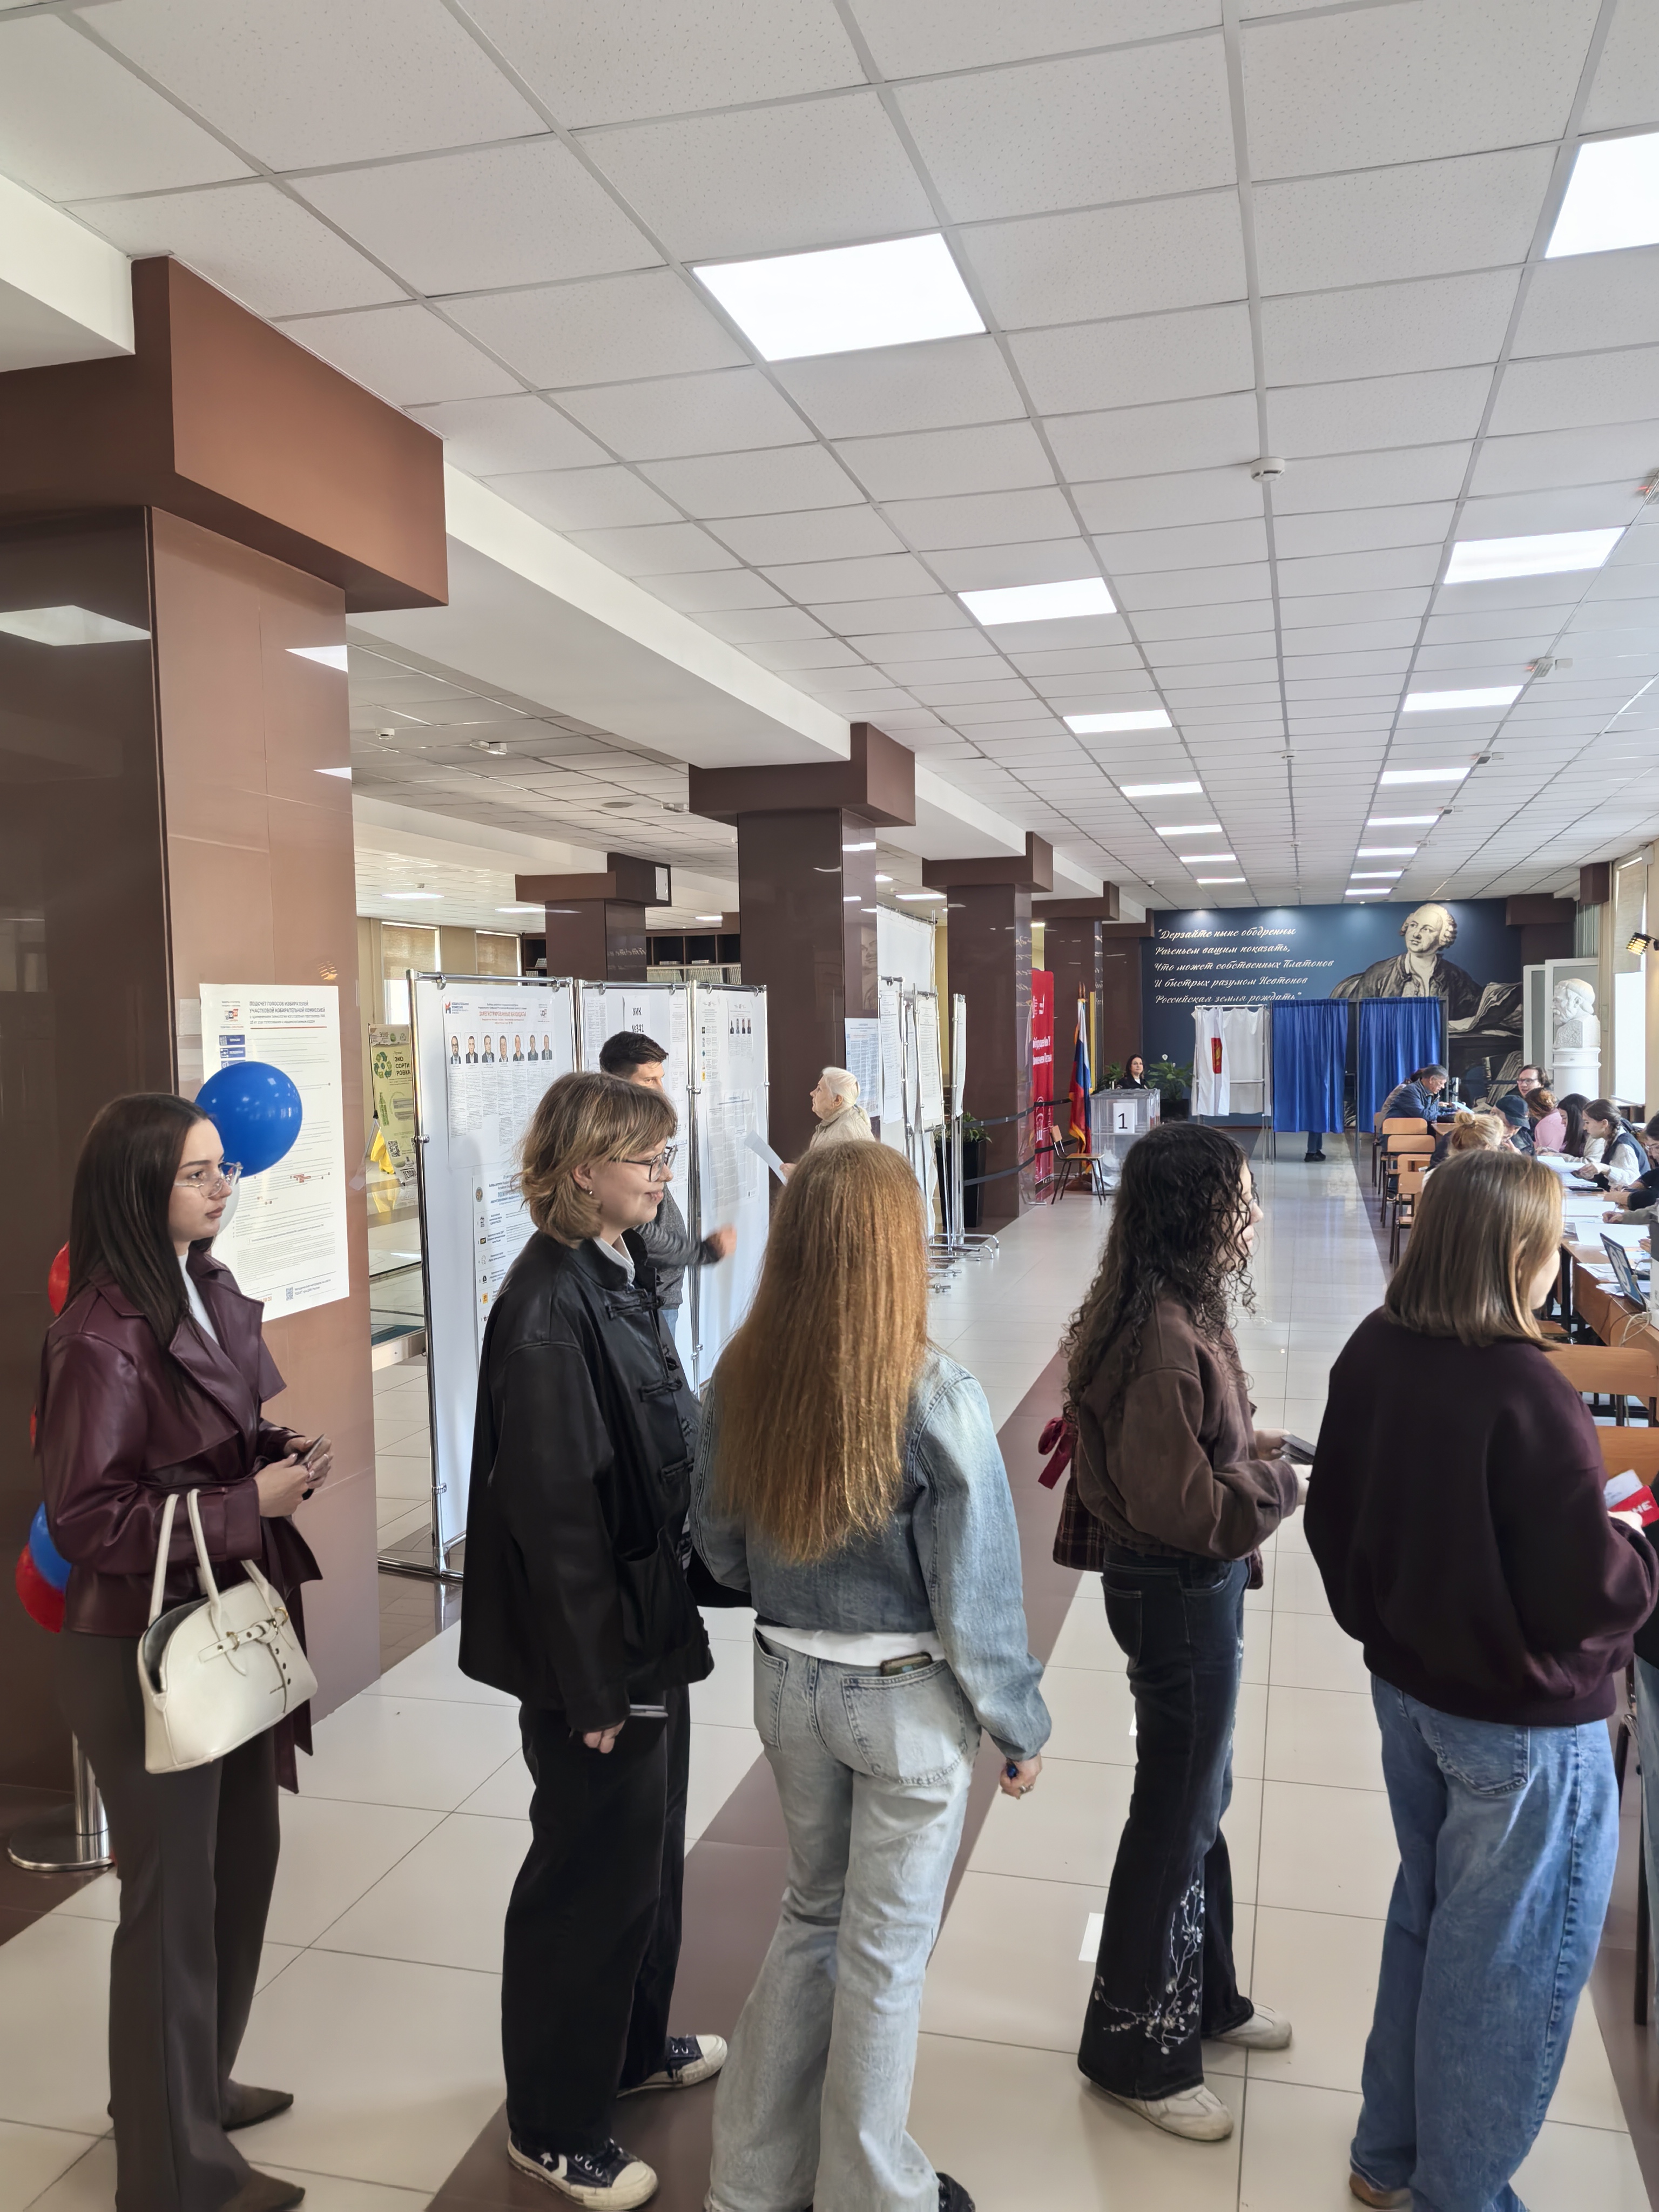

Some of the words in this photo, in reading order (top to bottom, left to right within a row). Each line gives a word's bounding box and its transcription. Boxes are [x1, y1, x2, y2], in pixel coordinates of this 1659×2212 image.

[1213, 929, 1240, 938] ныне
[1241, 926, 1297, 939] ободренны
[1155, 946, 1200, 955] Раченьем
[1202, 946, 1238, 955] вашим
[1240, 943, 1291, 953] показать,
[1154, 963, 1175, 971] Что
[1176, 962, 1214, 971] может
[1216, 960, 1282, 969] собственных
[1283, 959, 1334, 968] Платонов
[1154, 979, 1162, 988] И
[1164, 978, 1210, 989] быстрых
[1210, 978, 1257, 989] разумом
[1258, 976, 1309, 985] Невтонов
[1156, 995, 1212, 1003] Российская
[1215, 995, 1247, 1003] земля
[632, 1007, 642, 1016] УИК
[631, 1024, 644, 1033] №341
[1118, 1112, 1128, 1129] 1
